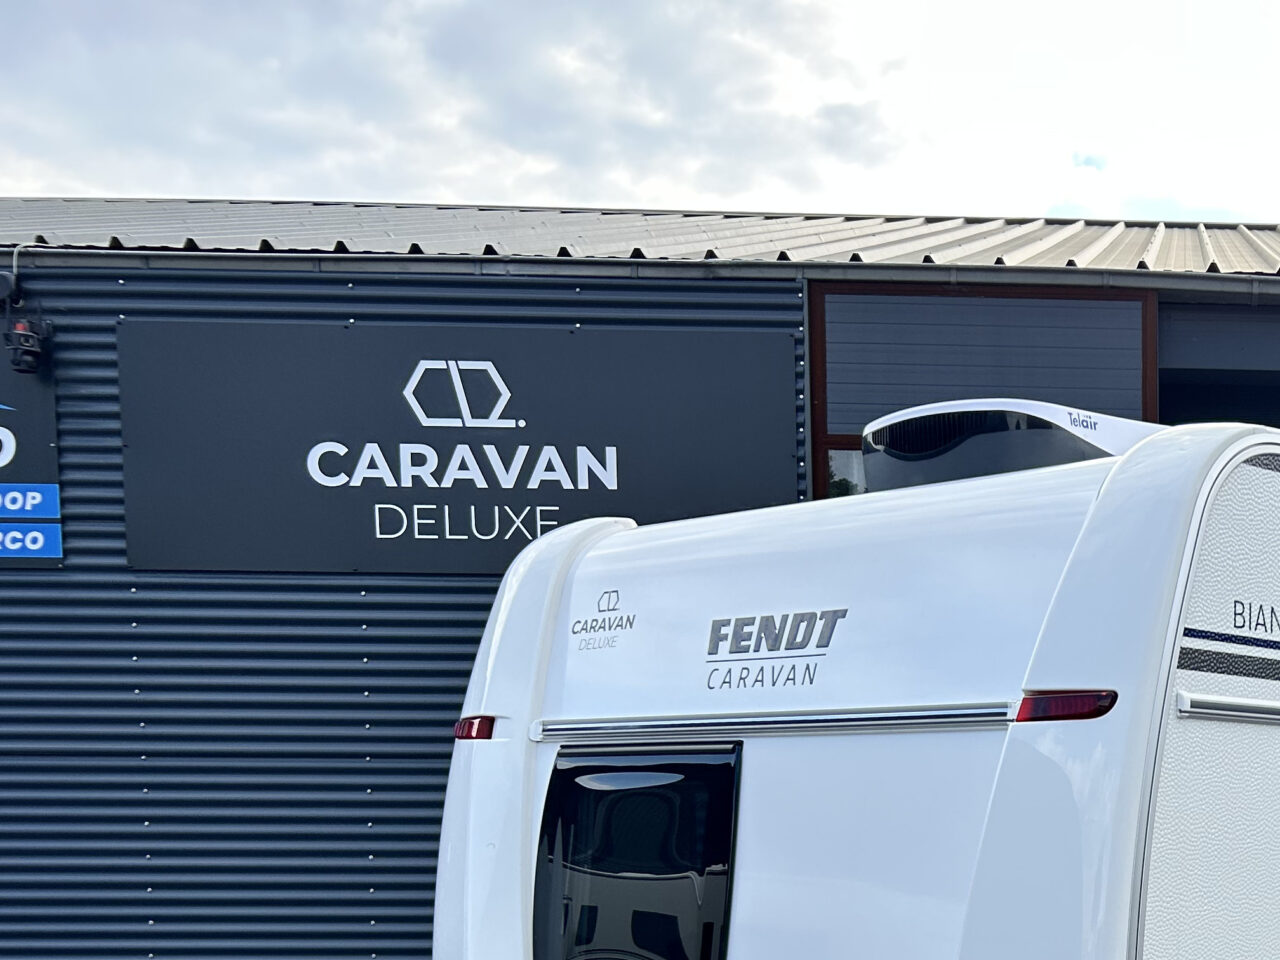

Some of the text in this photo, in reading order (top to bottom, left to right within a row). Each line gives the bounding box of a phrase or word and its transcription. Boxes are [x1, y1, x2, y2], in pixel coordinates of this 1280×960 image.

[1067, 411, 1098, 431] Telair
[306, 441, 618, 490] CARAVAN
[0, 491, 43, 510] OP
[0, 530, 45, 550] CO
[571, 614, 636, 635] CARAVAN
[707, 608, 849, 656] FENDT
[578, 635, 619, 651] DELUXE
[706, 662, 818, 690] CARAVAN
